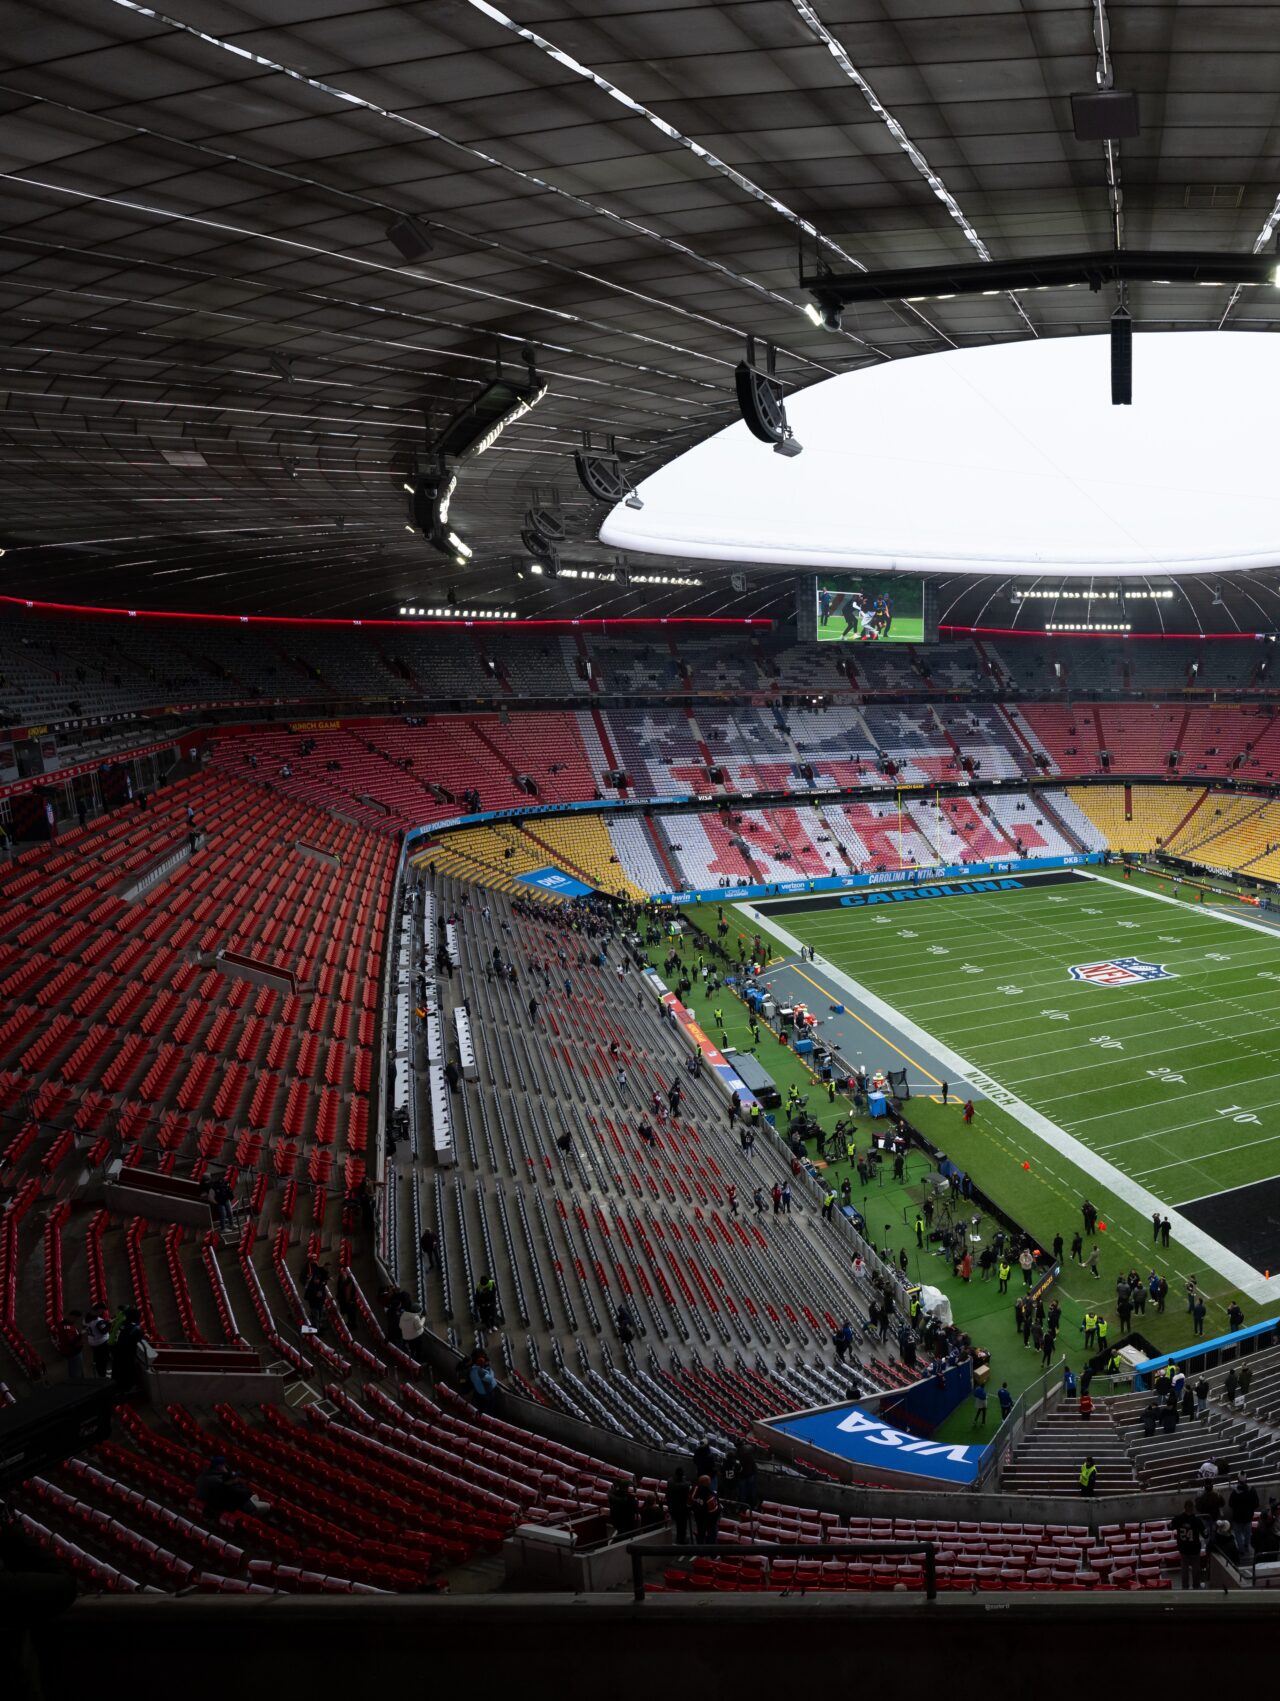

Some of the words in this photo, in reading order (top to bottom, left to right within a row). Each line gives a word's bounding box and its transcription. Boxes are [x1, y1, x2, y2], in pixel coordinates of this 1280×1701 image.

[318, 720, 341, 730] GAME
[1064, 856, 1078, 865] DKB
[536, 875, 566, 888] DKB
[869, 870, 905, 884] CAROLINA
[907, 867, 945, 882] PNTHRS
[781, 881, 805, 890] verizon
[671, 894, 691, 903] bwin
[839, 879, 1025, 907] CAROLINA
[1078, 963, 1130, 984] NFL
[996, 985, 1024, 995] 50
[1040, 1009, 1067, 1020] 40
[1089, 1035, 1119, 1049] 30
[1147, 1067, 1181, 1083] 20
[962, 1070, 1019, 1108] MUNICH
[1216, 1104, 1257, 1124] 10
[836, 1411, 973, 1464] VISA
[1179, 1528, 1193, 1541] 24
